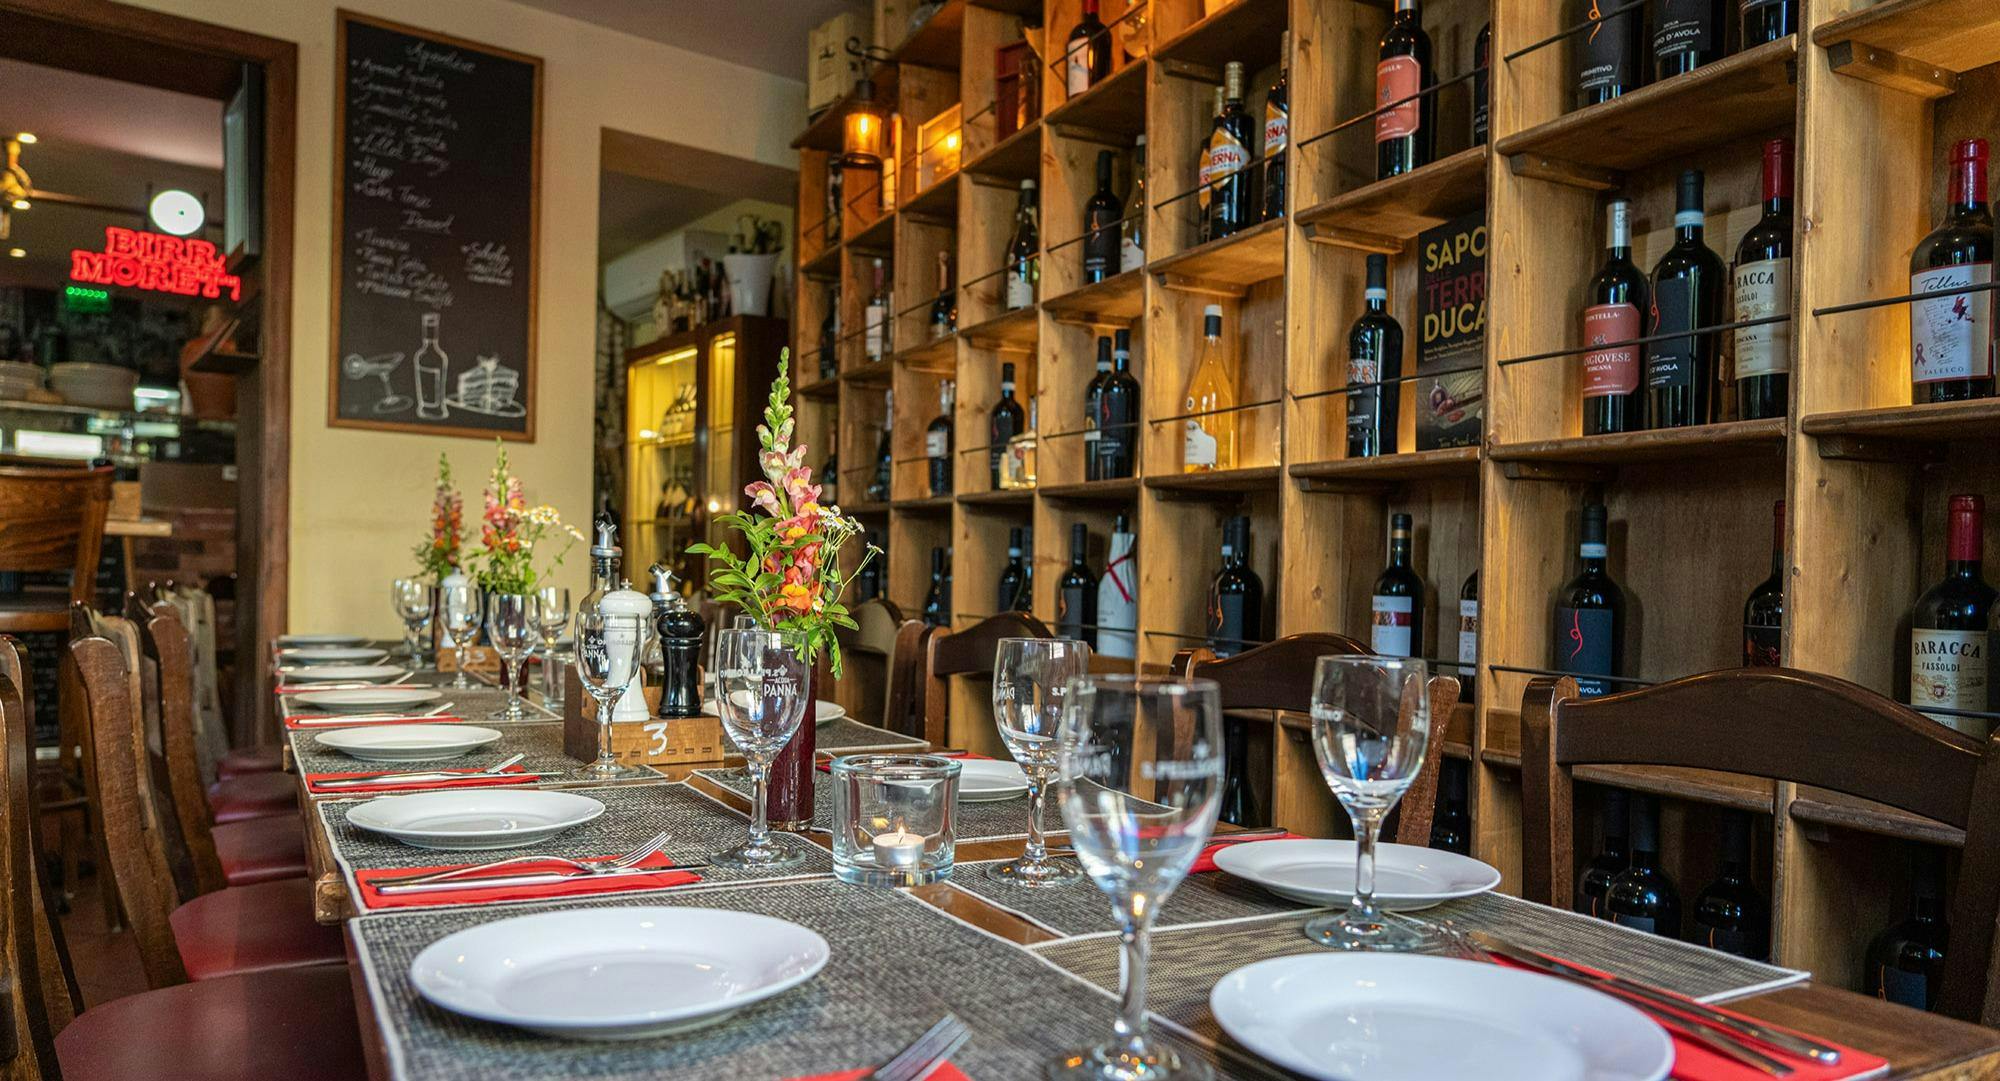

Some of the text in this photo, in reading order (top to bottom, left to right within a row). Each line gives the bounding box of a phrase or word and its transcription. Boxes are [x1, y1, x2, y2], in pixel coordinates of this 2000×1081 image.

[1666, 28, 1701, 42] D'AVOLA
[1212, 151, 1241, 166] ERNA
[1734, 271, 1775, 289] RACCA
[1921, 275, 1971, 293] Tellus
[1584, 352, 1631, 366] NGIOVESE
[1914, 640, 1981, 659] BARACCA
[1921, 661, 1961, 672] FASSOLDI
[763, 683, 798, 698] PANNA
[643, 722, 668, 756] 3
